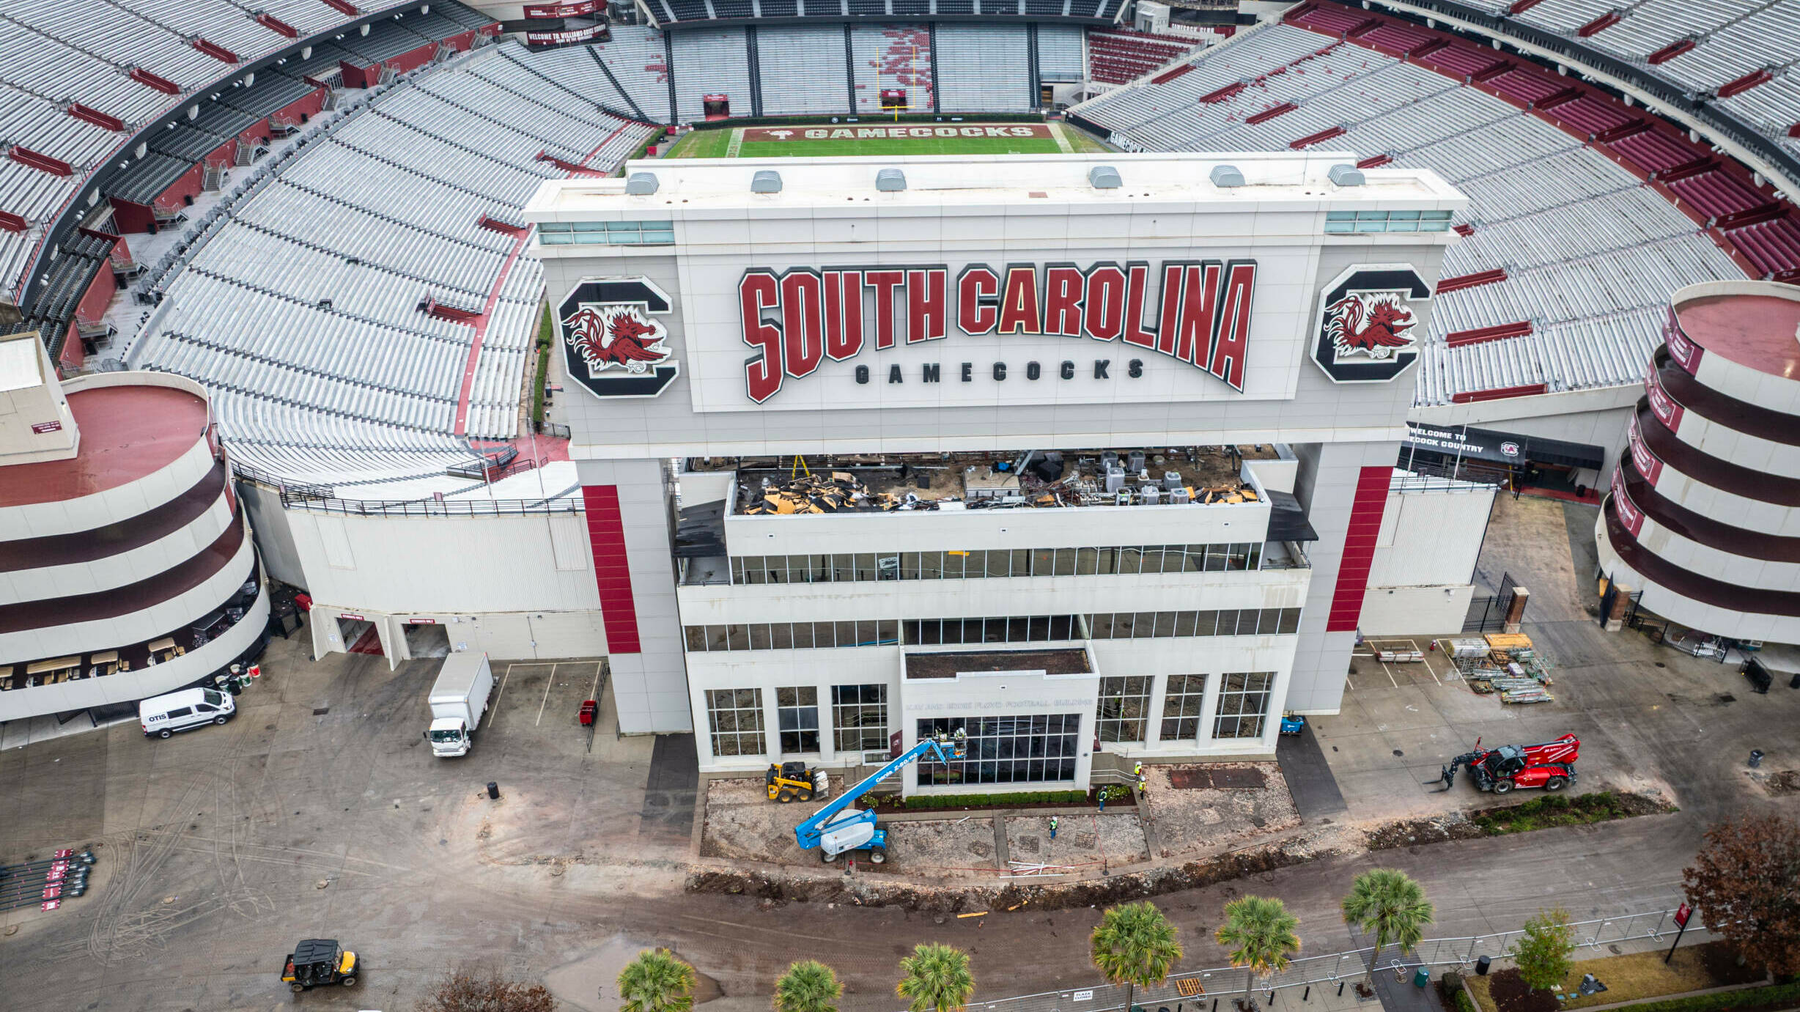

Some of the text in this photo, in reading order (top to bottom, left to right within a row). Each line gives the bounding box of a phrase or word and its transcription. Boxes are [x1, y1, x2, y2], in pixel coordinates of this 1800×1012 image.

[804, 126, 1035, 139] GAMECOCKS
[738, 259, 1258, 405] SOUTH CAROLINA
[855, 359, 1144, 384] GAMECOCKS
[1410, 427, 1466, 441] WELCOME TO
[1407, 437, 1484, 453] ECOCK COUNTRY
[1005, 699, 1049, 708] FOOTBALL
[149, 713, 166, 722] OTIS
